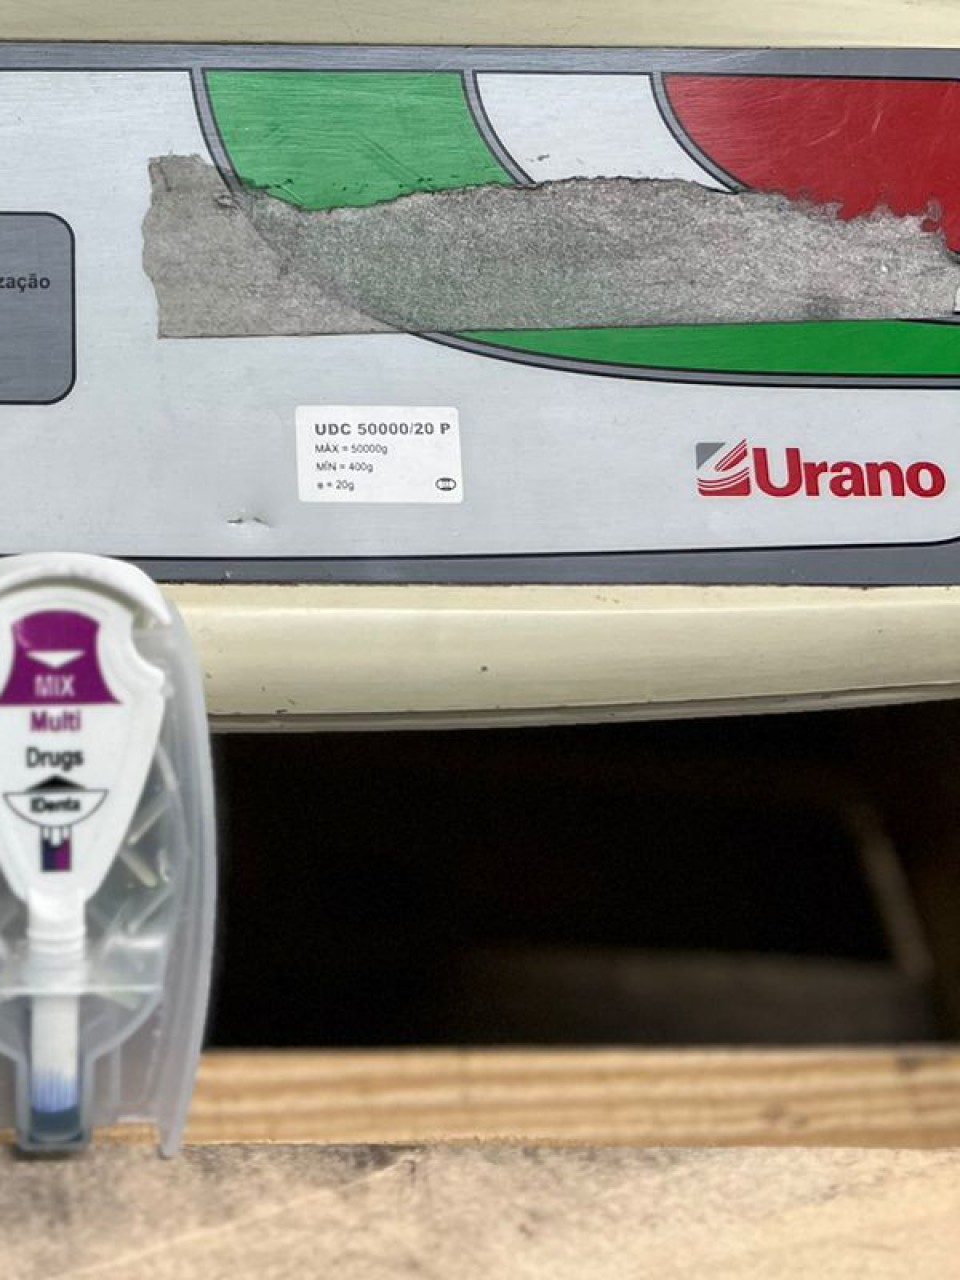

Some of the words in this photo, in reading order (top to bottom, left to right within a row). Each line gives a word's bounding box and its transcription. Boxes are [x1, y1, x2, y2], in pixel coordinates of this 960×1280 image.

[314, 423, 351, 436] UDC
[357, 422, 435, 436] 50000/20
[440, 422, 451, 435] P
[351, 444, 388, 455] 50000g
[348, 461, 374, 473] 400g
[752, 447, 946, 497] Urano
[335, 480, 355, 492] 20g
[34, 674, 75, 697] MIX
[29, 709, 82, 732] Multi
[25, 746, 84, 772] Drugs
